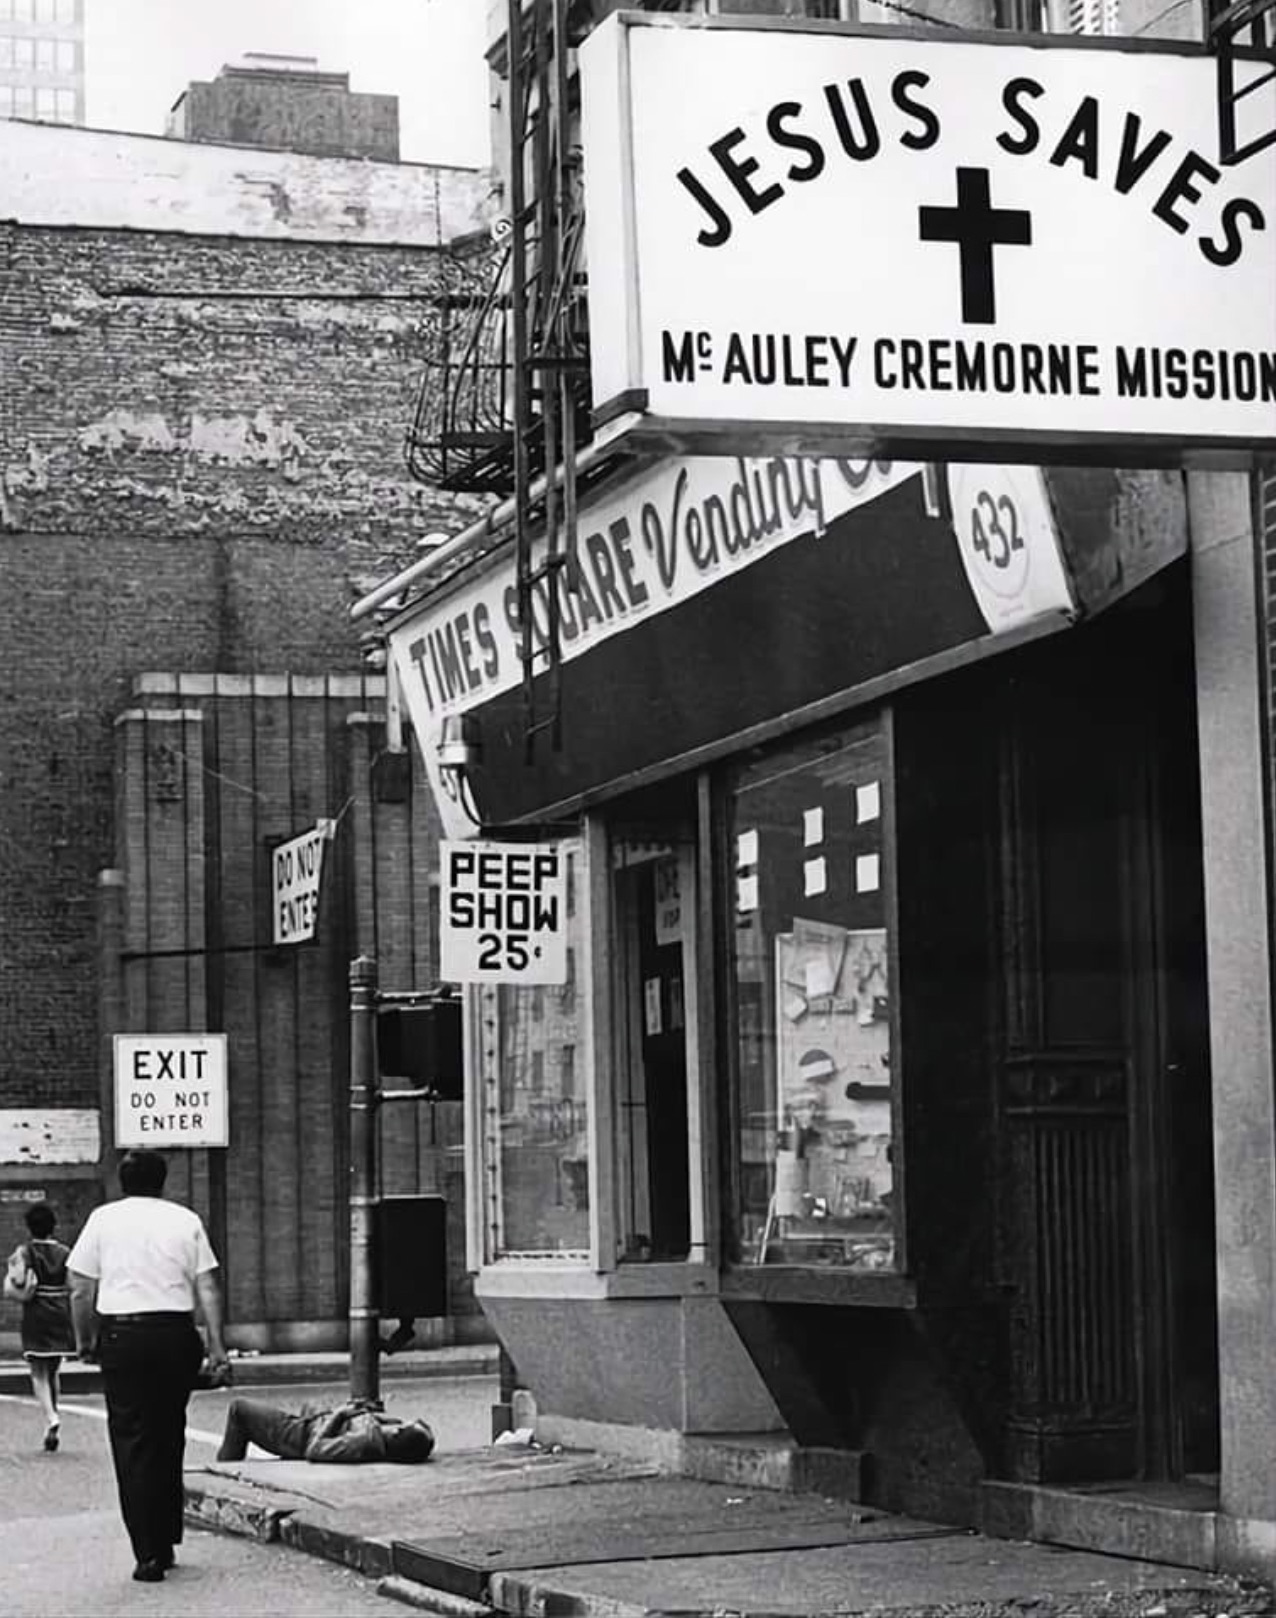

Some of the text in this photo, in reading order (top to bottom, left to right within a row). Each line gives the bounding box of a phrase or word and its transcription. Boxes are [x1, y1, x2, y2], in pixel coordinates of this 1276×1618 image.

[676, 70, 1266, 267] JESUS SAVES
[723, 333, 858, 388] AULEY
[873, 338, 1100, 396] CREMORNE
[1115, 345, 1276, 403] MISSION
[971, 489, 1024, 569] 432
[409, 602, 499, 711] TIMES
[641, 456, 825, 590] Vending
[277, 837, 321, 890] DO NOT
[450, 852, 558, 891] PEEP
[450, 891, 558, 932] SHOW
[133, 1050, 208, 1079] EXIT
[130, 1091, 210, 1109] DO NOT
[140, 1113, 203, 1131] ENTER
